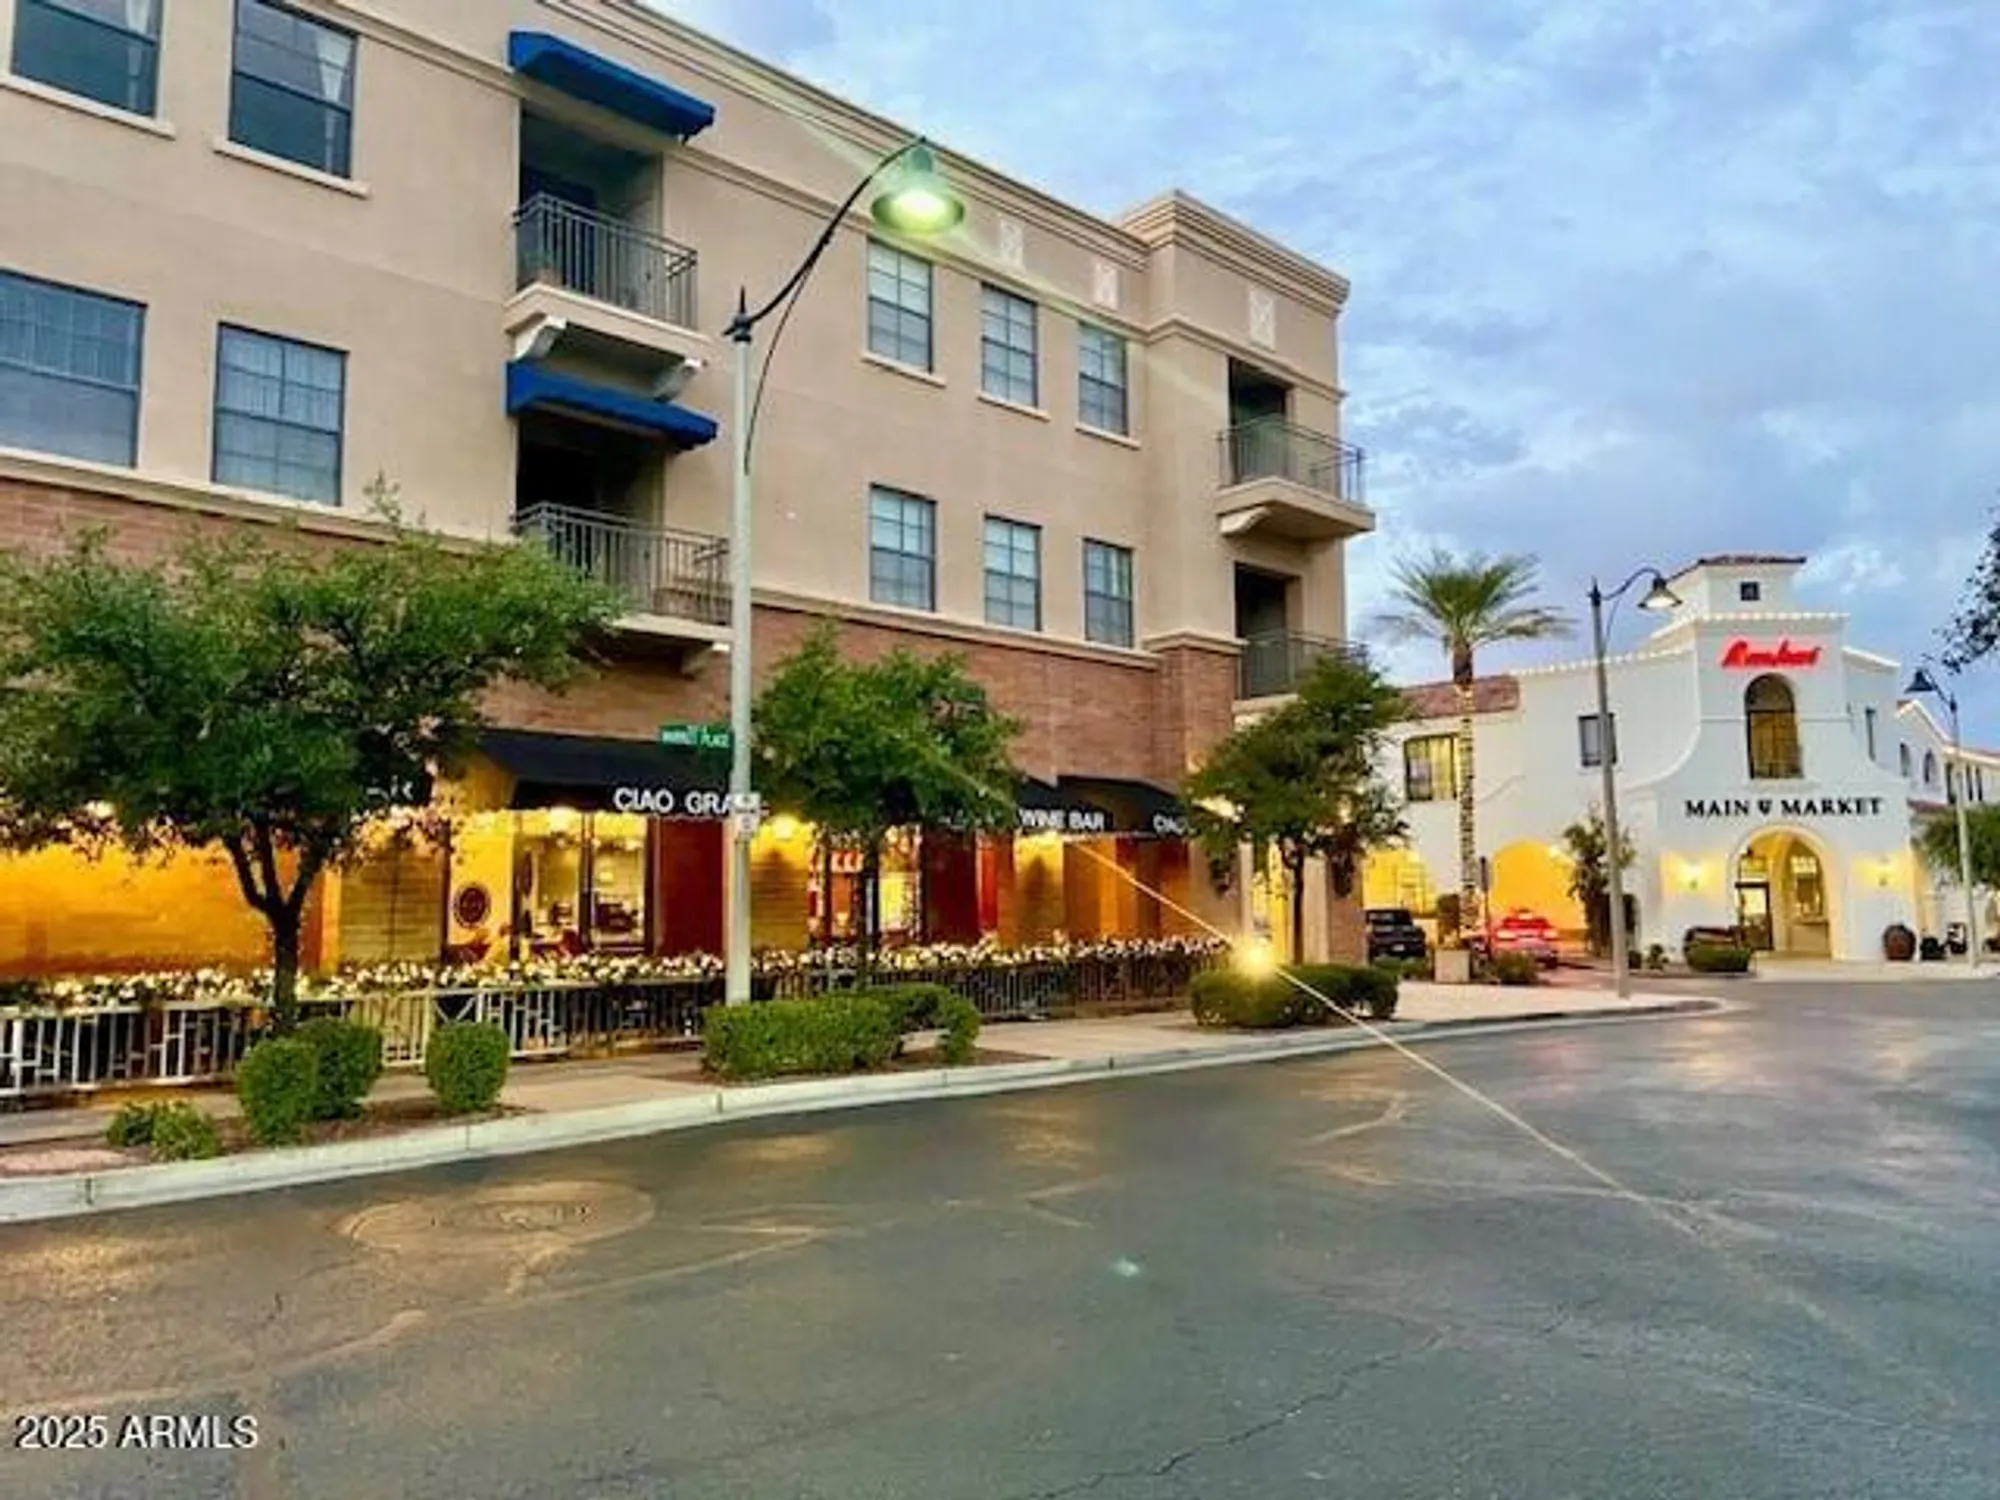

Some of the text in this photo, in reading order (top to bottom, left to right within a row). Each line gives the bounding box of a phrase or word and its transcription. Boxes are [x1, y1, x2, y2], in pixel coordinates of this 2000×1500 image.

[613, 787, 674, 813] CIAO
[1685, 799, 1749, 817] MAIN
[1780, 797, 1884, 816] MARKET
[1019, 808, 1105, 831] WINE BAR
